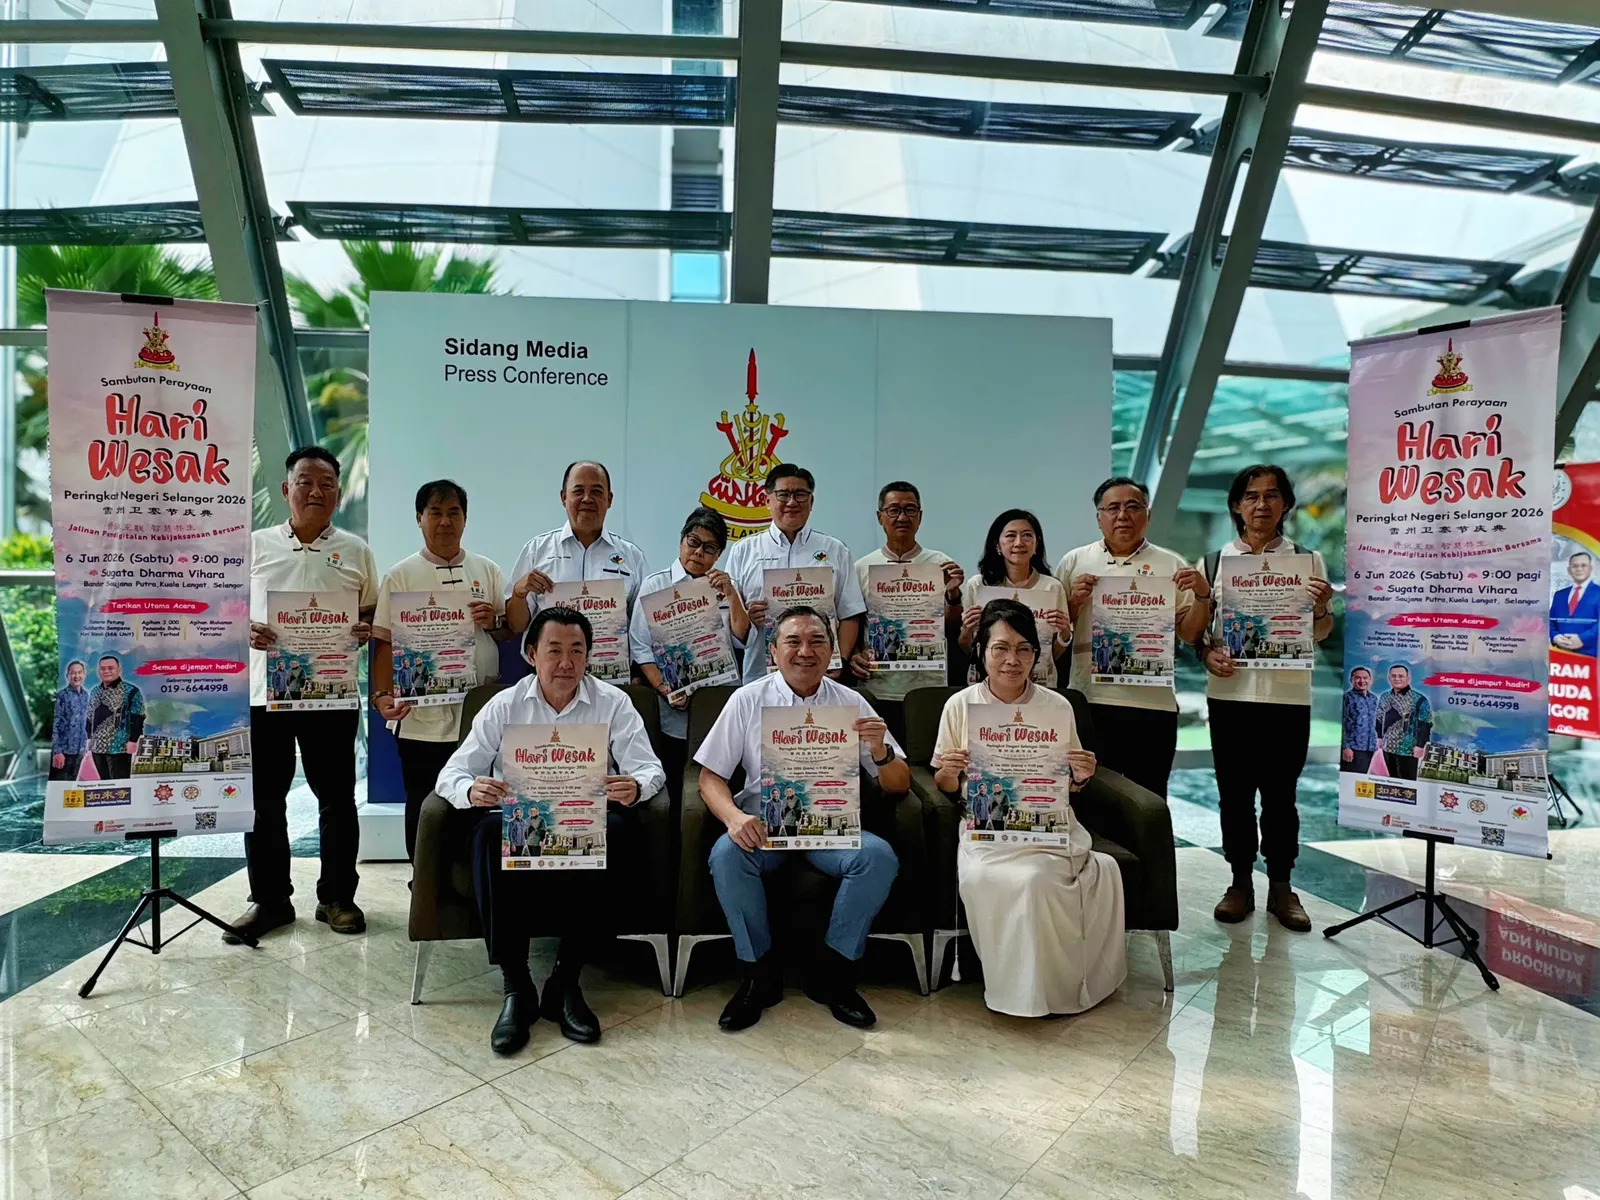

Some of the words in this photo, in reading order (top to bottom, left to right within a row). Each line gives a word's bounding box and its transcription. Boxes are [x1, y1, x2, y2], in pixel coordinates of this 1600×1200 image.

[445, 338, 519, 361] Sidang
[526, 340, 589, 359] Media
[445, 364, 497, 383] Press
[503, 366, 608, 386] Conference
[101, 375, 155, 387] Sambutan
[159, 376, 212, 394] Perayaan
[1394, 402, 1449, 418] Sambutan
[1452, 399, 1507, 409] Perayaan
[105, 393, 208, 441] Hari
[1397, 413, 1502, 461] Hari
[88, 439, 230, 486] Wesak
[1379, 457, 1526, 505] Wesak
[64, 490, 119, 503] Peringkat
[121, 490, 159, 504] Negeri
[162, 493, 214, 505] Selangor
[218, 495, 246, 505] 2026
[1356, 514, 1408, 524] Peringkat
[1411, 511, 1450, 522] Negeri
[1454, 510, 1507, 521] Selangor
[1511, 508, 1544, 518] 2026
[68, 523, 99, 536] Jalinan
[151, 531, 210, 542] Kebijaksanaan
[213, 524, 245, 536] Bersama
[1358, 544, 1385, 554] Jalinan
[1388, 549, 1438, 558] Pendigitalan
[1441, 547, 1502, 559] Kebijaksanaan
[1505, 537, 1542, 551] Bersama
[66, 554, 73, 563] 6
[79, 554, 99, 563] Jun
[103, 554, 124, 562] 2026
[129, 554, 174, 565] (Sabtu)
[192, 555, 219, 563] 9:00
[223, 556, 244, 566] pagi
[101, 569, 134, 579] Sugata
[140, 569, 183, 578] Dharma
[189, 570, 224, 578] Vihara
[1232, 576, 1260, 587] Hari
[1263, 574, 1302, 586] Wesak
[1365, 571, 1384, 579] Jun
[1389, 571, 1415, 579] 2026
[1420, 571, 1463, 581] (Sabtu)
[1482, 570, 1511, 579] 9:00
[1517, 571, 1541, 581] pagi
[772, 586, 794, 598] Hari
[796, 585, 825, 596] Wesak
[877, 581, 901, 593] Hari
[903, 581, 935, 592] Wesak
[1387, 585, 1424, 595] Sugata
[1430, 585, 1473, 593] Dharma
[1478, 585, 1518, 594] Vihara
[583, 598, 617, 611] Wesak
[1102, 594, 1128, 606] Hari
[1130, 594, 1166, 606] Wesak
[400, 610, 427, 623] Hari
[430, 609, 465, 621] Wesak
[653, 605, 676, 622] Hari
[677, 596, 710, 614] Wesak
[278, 611, 307, 624] Hari
[310, 611, 349, 624] Wesak
[161, 684, 228, 693] 019-6644998
[1440, 676, 1464, 684] Semua
[1468, 678, 1502, 687] dijemput
[1448, 697, 1519, 710] 019-6644998
[772, 730, 802, 745] Hari
[806, 728, 848, 744] Wesak
[979, 727, 1011, 742] Hari
[1015, 728, 1058, 742] Wesak
[515, 748, 548, 764] Hari
[552, 748, 596, 762] Wesak
